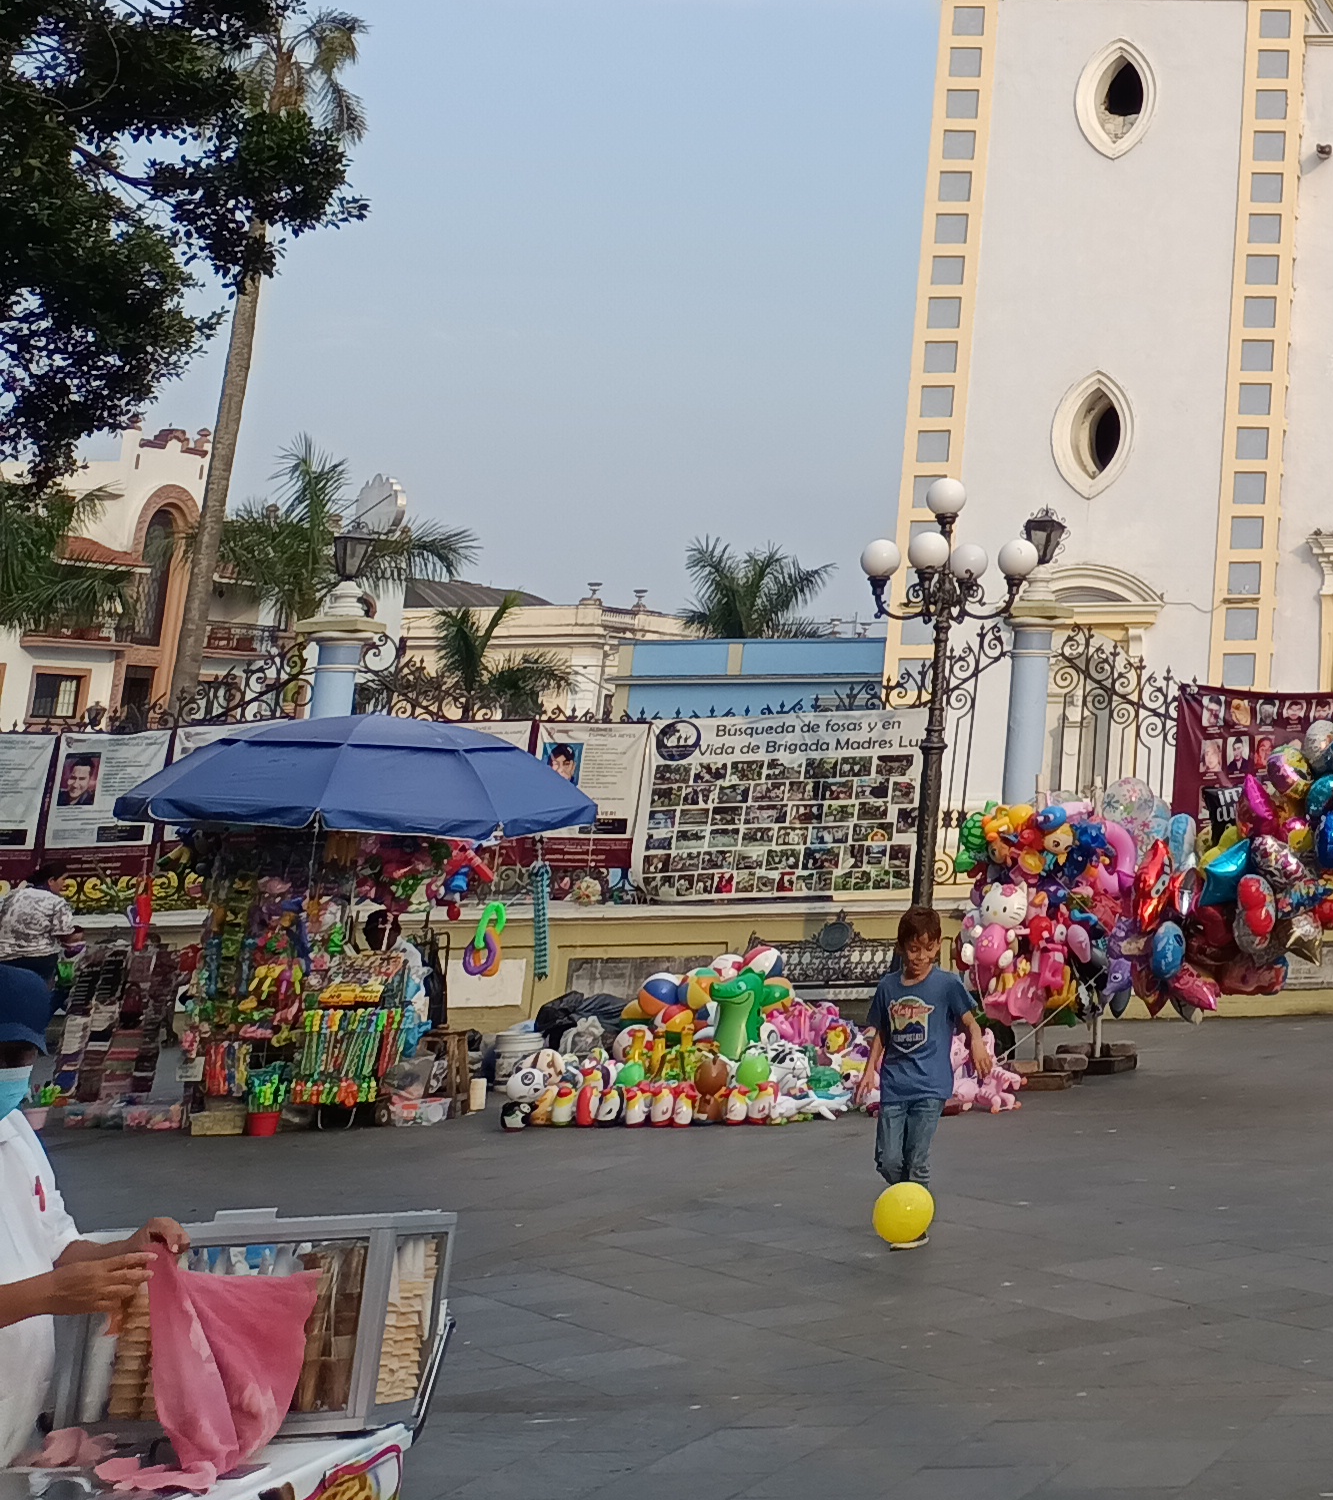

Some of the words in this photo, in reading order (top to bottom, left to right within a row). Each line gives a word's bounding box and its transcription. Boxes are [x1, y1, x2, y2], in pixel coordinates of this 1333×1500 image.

[715, 722, 796, 738] Búsqueda
[800, 719, 821, 733] de
[826, 718, 863, 733] fosas
[867, 721, 878, 733] y
[882, 719, 902, 731] en
[699, 742, 735, 757] Vida
[739, 741, 761, 755] de
[765, 739, 830, 756] Brigada
[835, 736, 894, 751] Madres
[899, 735, 926, 748] Lu
